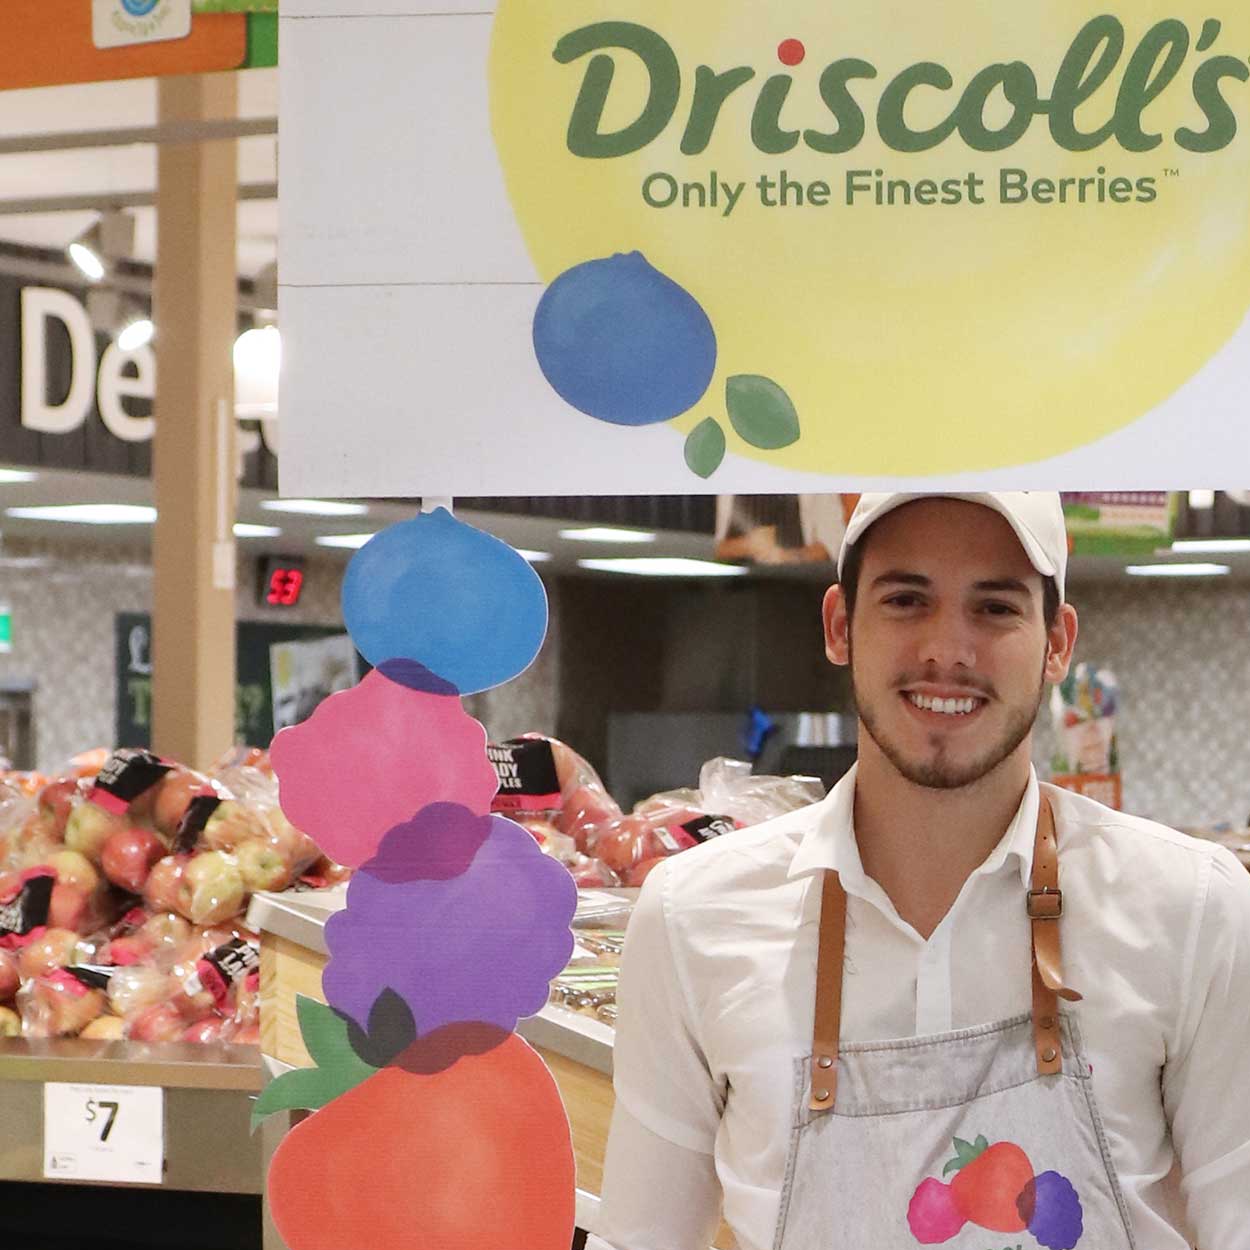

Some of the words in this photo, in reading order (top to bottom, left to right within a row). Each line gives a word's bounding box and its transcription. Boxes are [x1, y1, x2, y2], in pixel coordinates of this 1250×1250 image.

[552, 14, 1250, 159] Driscoll's
[642, 171, 744, 217] Only
[756, 171, 831, 207] the
[845, 168, 985, 206] Finest
[998, 166, 1157, 205] Berries
[488, 748, 514, 762] INK
[85, 1098, 119, 1141] $7
